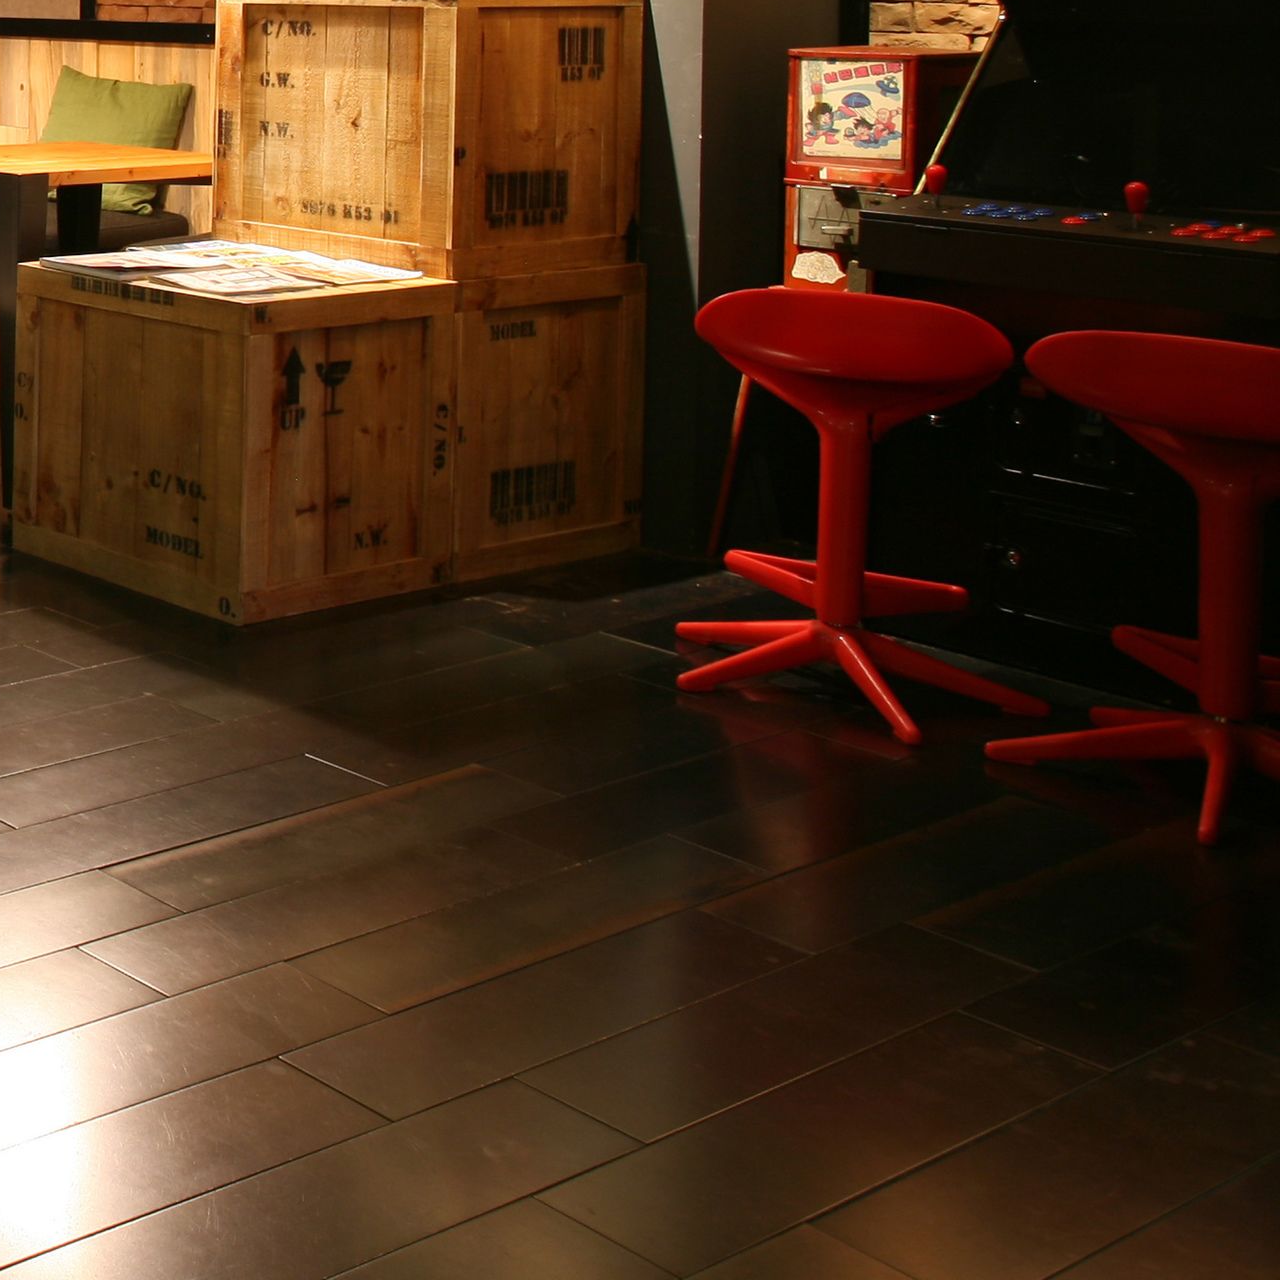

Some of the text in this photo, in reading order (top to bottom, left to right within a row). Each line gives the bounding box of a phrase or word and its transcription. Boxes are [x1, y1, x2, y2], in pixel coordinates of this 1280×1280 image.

[260, 72, 294, 88] G.W.
[260, 121, 294, 138] N.W.
[281, 408, 306, 431] UP
[146, 525, 204, 560] MODEL
[354, 528, 388, 550] N.W.
